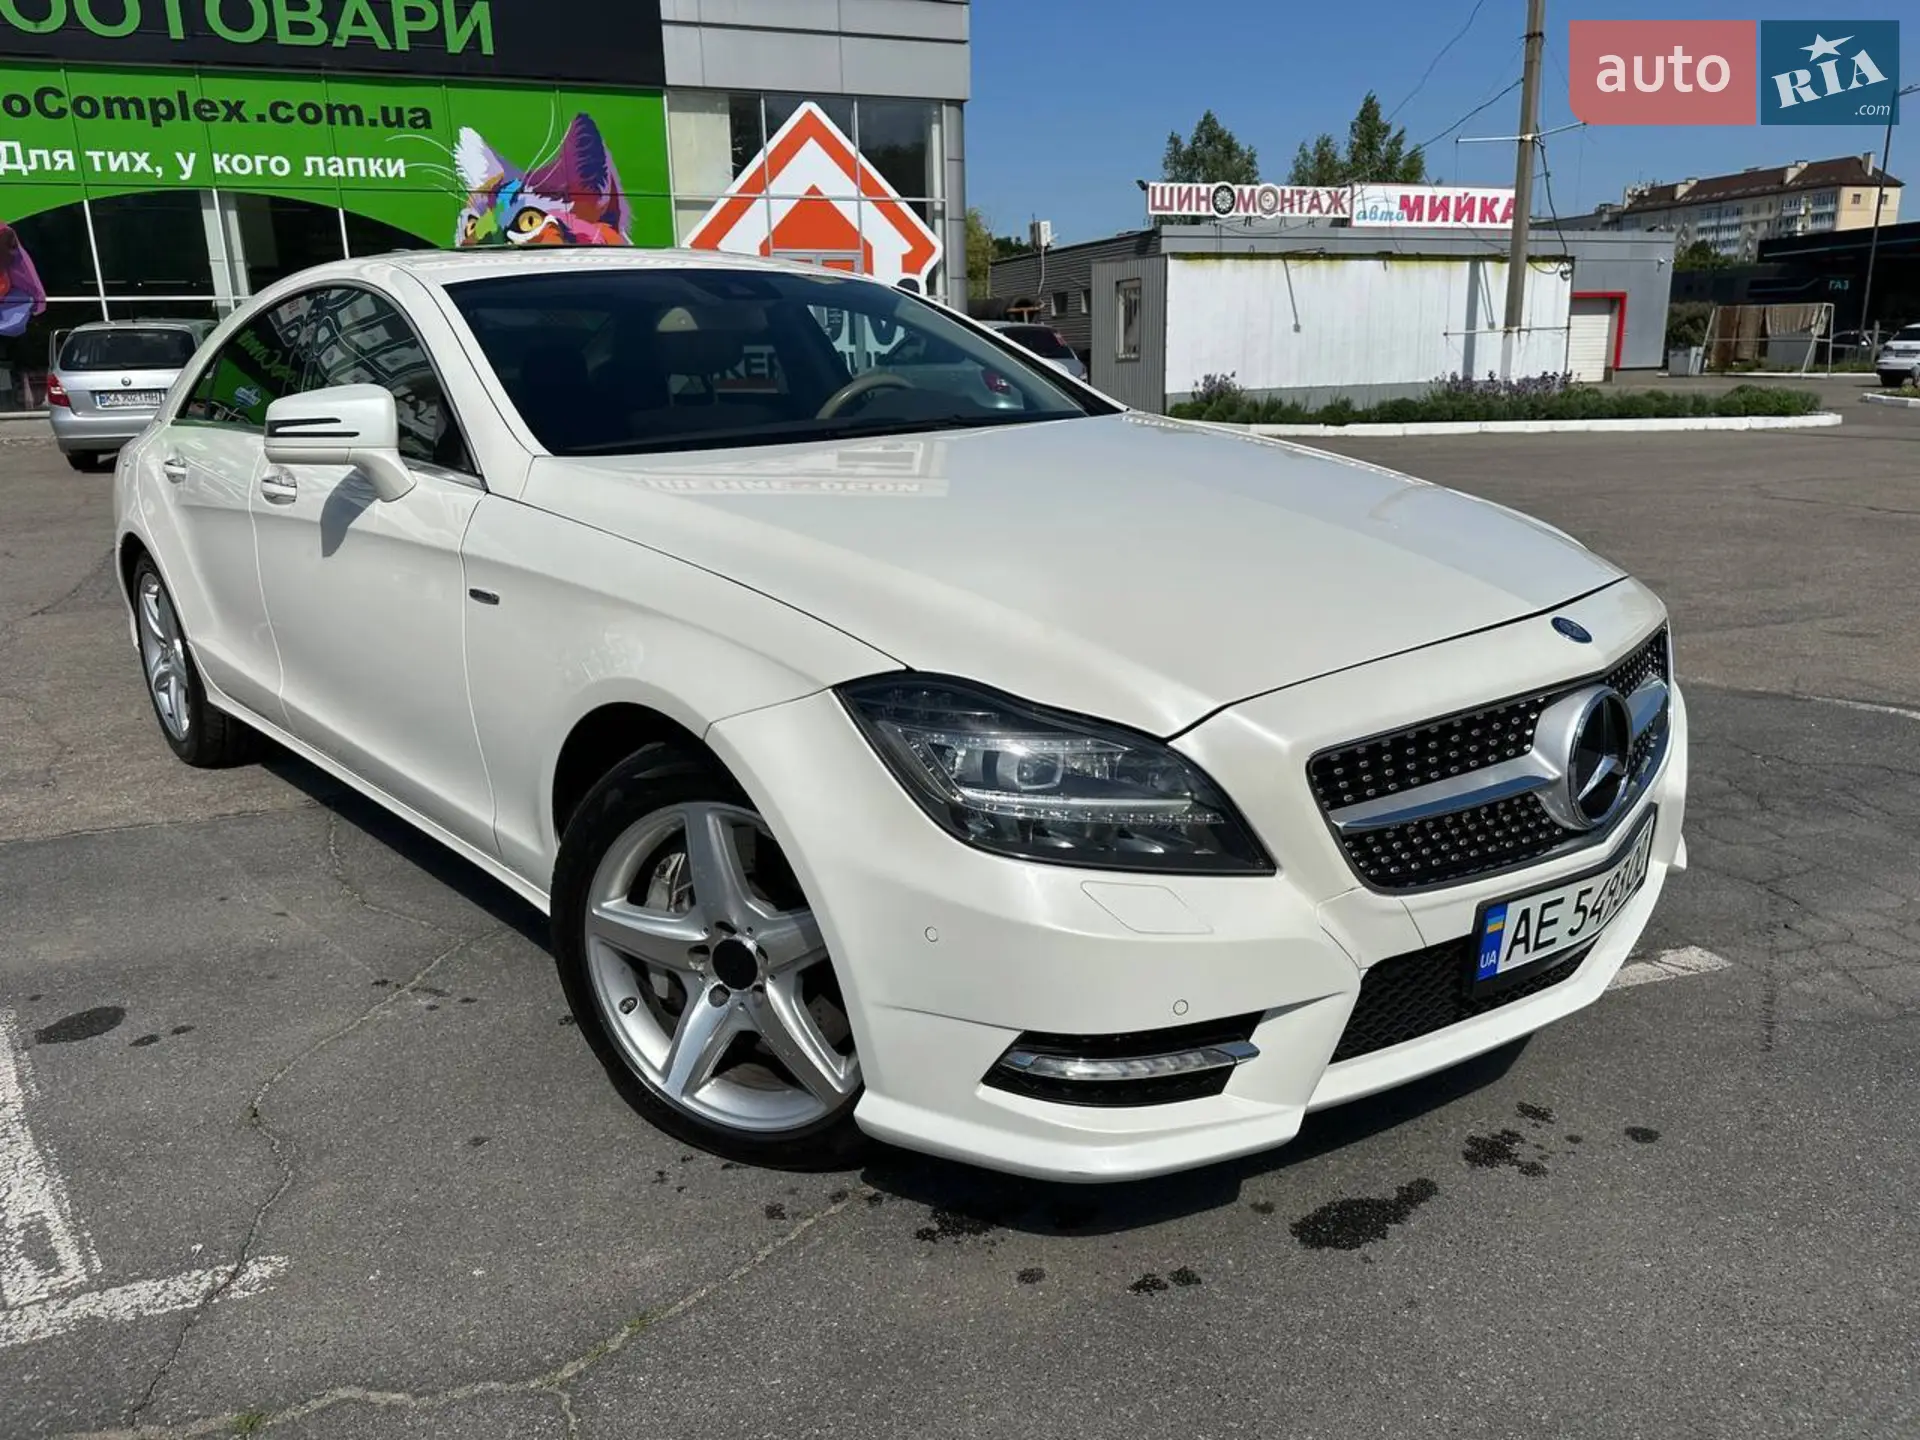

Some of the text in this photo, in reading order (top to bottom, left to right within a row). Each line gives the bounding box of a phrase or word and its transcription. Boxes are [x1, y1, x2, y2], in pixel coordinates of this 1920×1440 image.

[0, 140, 406, 181] Для тих, у кого лапки
[1151, 184, 1348, 216] ШИНОМОНТАЖ
[1356, 205, 1405, 221] авто
[1828, 279, 1850, 291] ГАЗ
[1505, 896, 1565, 962] AE
[1480, 950, 1497, 968] UA
